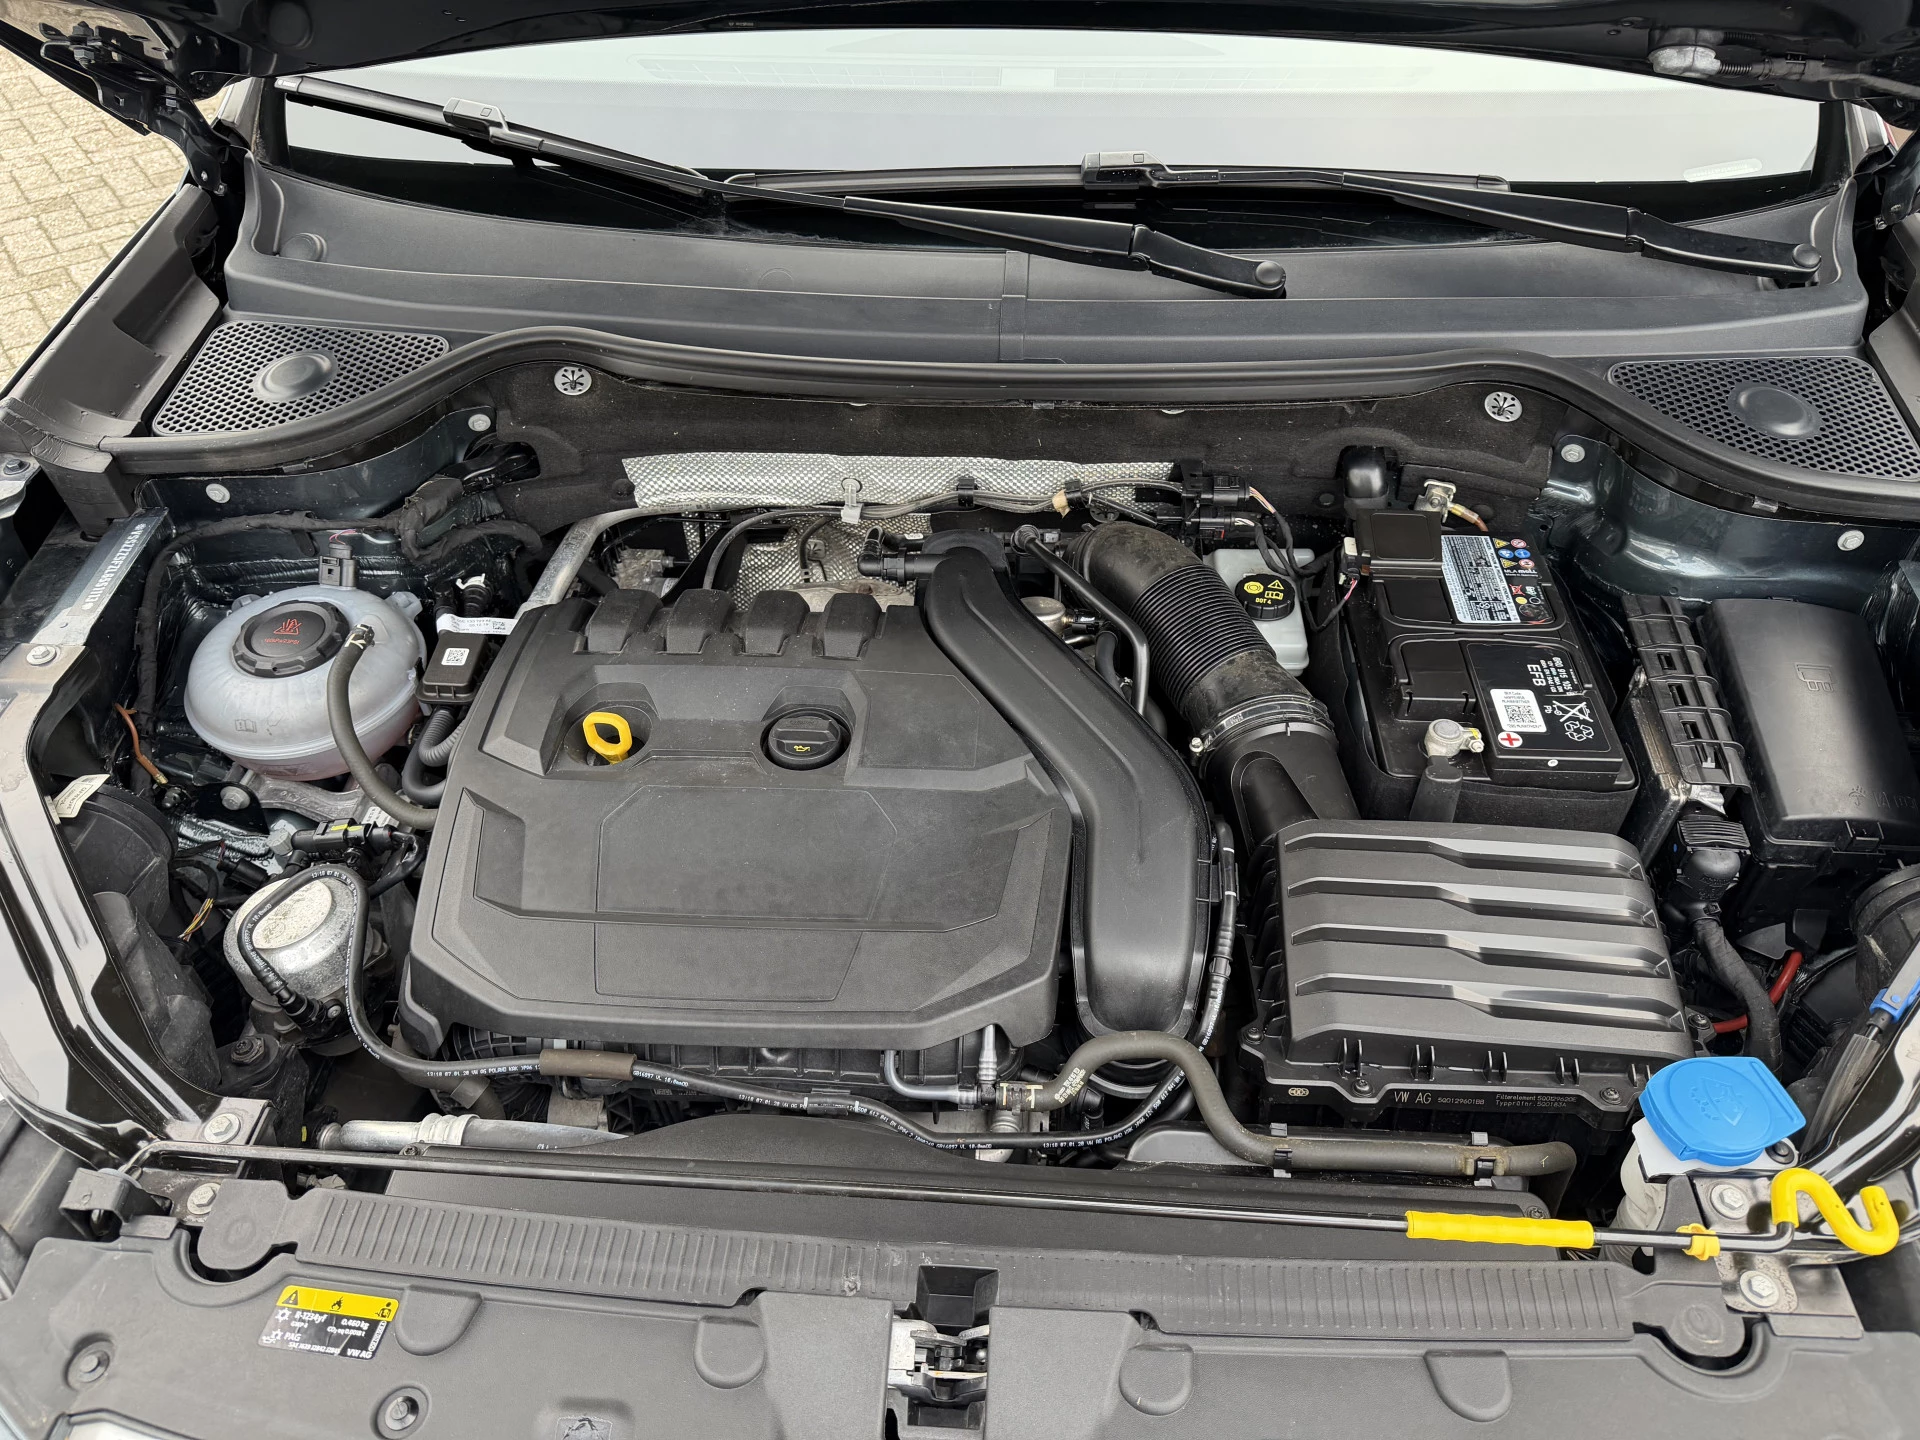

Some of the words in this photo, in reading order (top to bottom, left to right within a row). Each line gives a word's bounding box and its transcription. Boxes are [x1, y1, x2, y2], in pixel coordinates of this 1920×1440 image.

[1527, 664, 1546, 686] EFB
[1543, 705, 1552, 714] Pb
[1395, 1091, 1410, 1103] VW
[1415, 1092, 1432, 1104] AG
[284, 1331, 302, 1341] PAG
[346, 1348, 361, 1356] VW
[361, 1349, 373, 1359] AG
